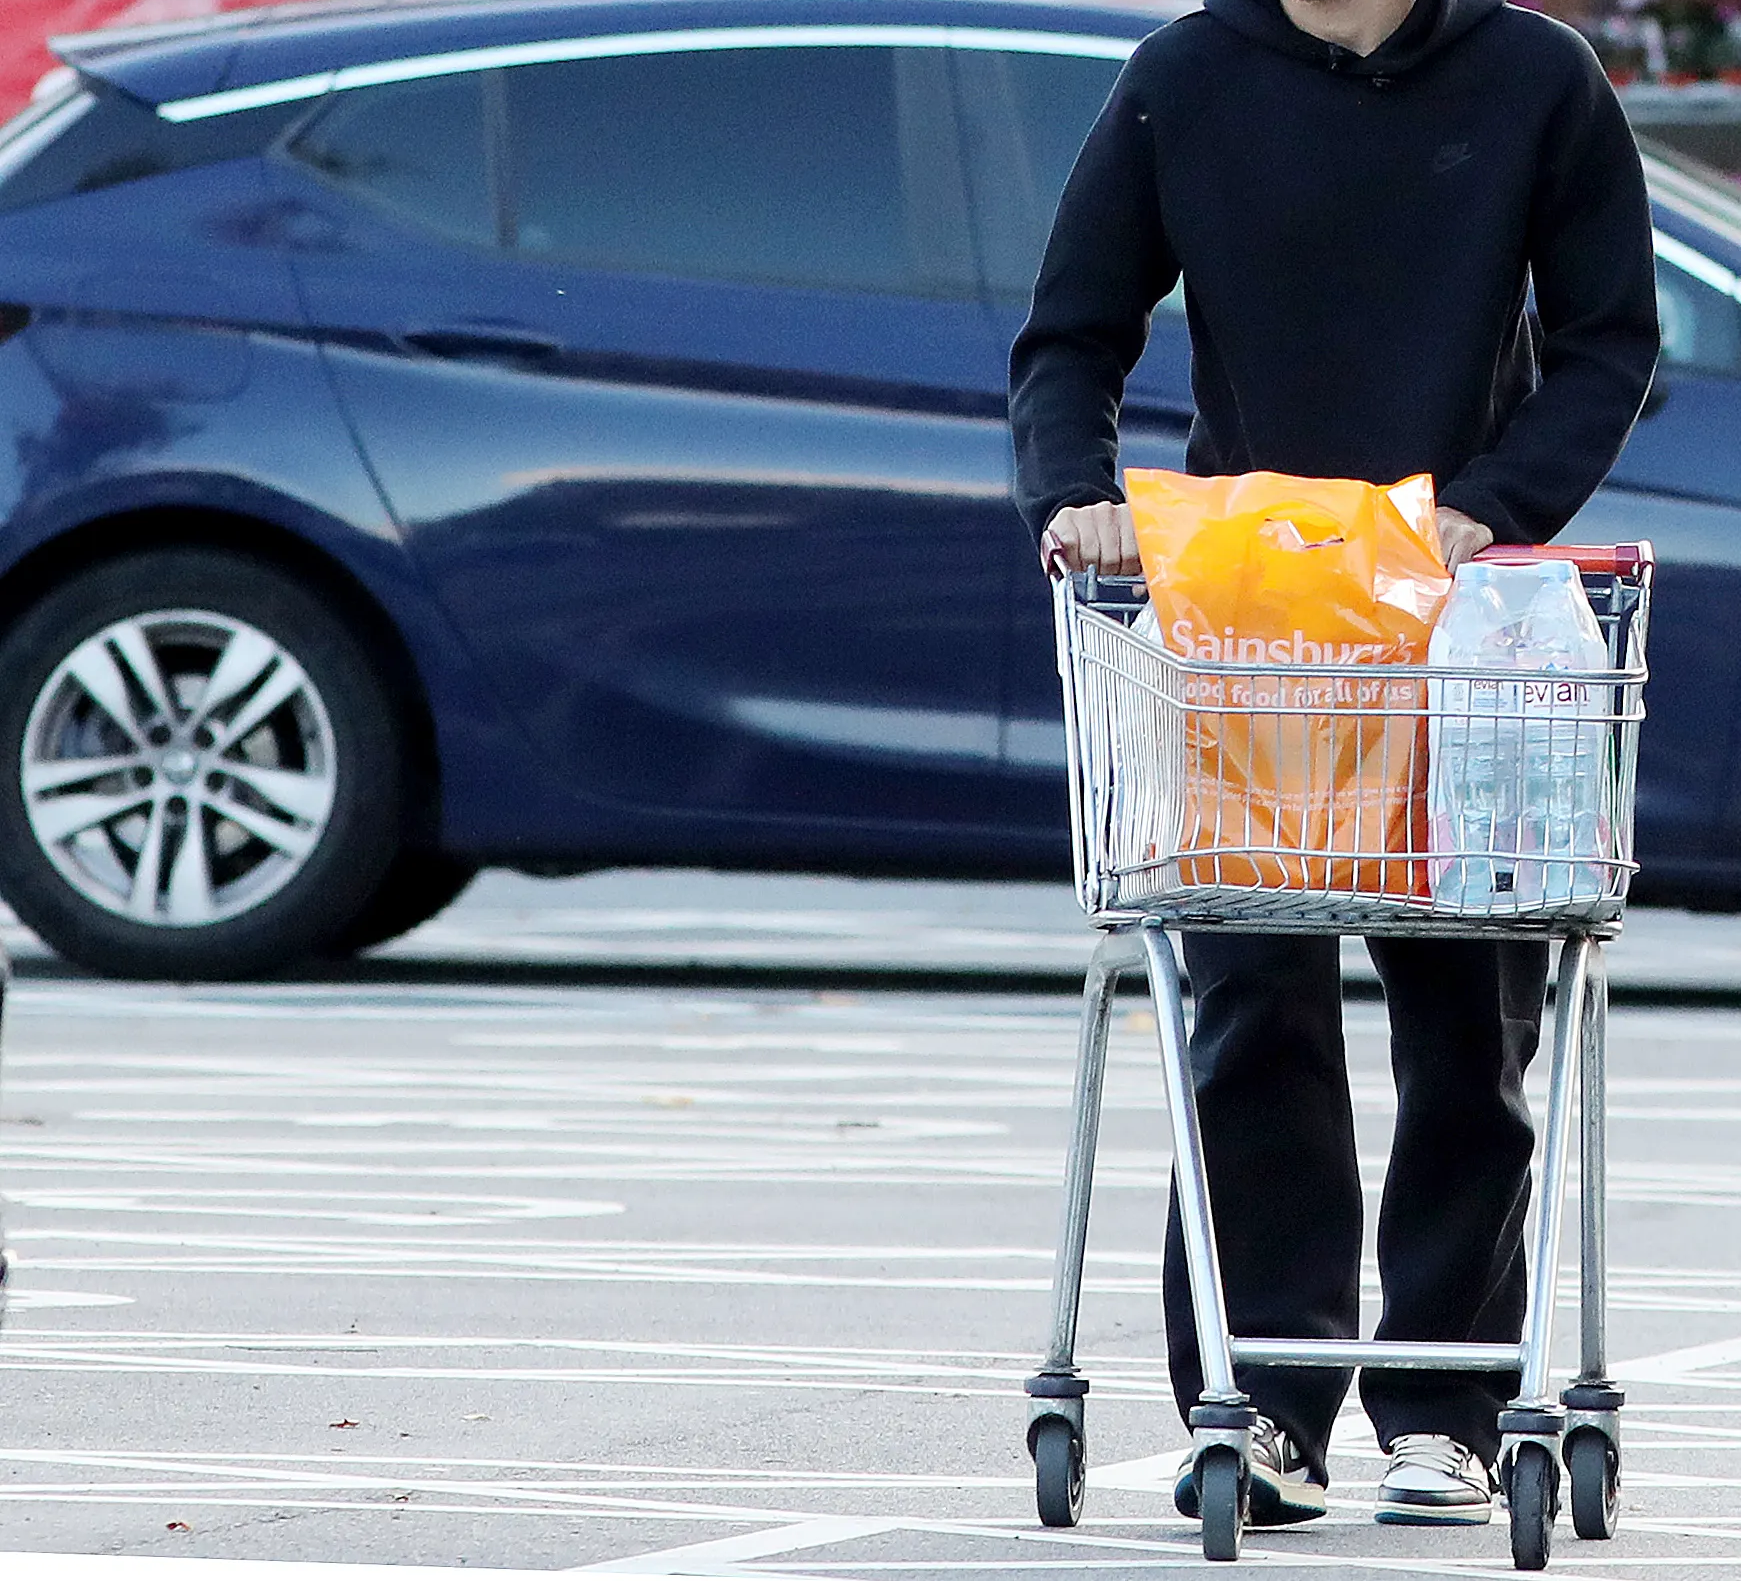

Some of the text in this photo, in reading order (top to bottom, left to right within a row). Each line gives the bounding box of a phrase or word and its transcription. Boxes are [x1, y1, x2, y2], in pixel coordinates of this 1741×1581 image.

[1231, 683, 1287, 707] food
[1294, 686, 1321, 707] for
[1325, 679, 1352, 703] all
[1357, 680, 1380, 702] of
[1524, 682, 1588, 704] evan
